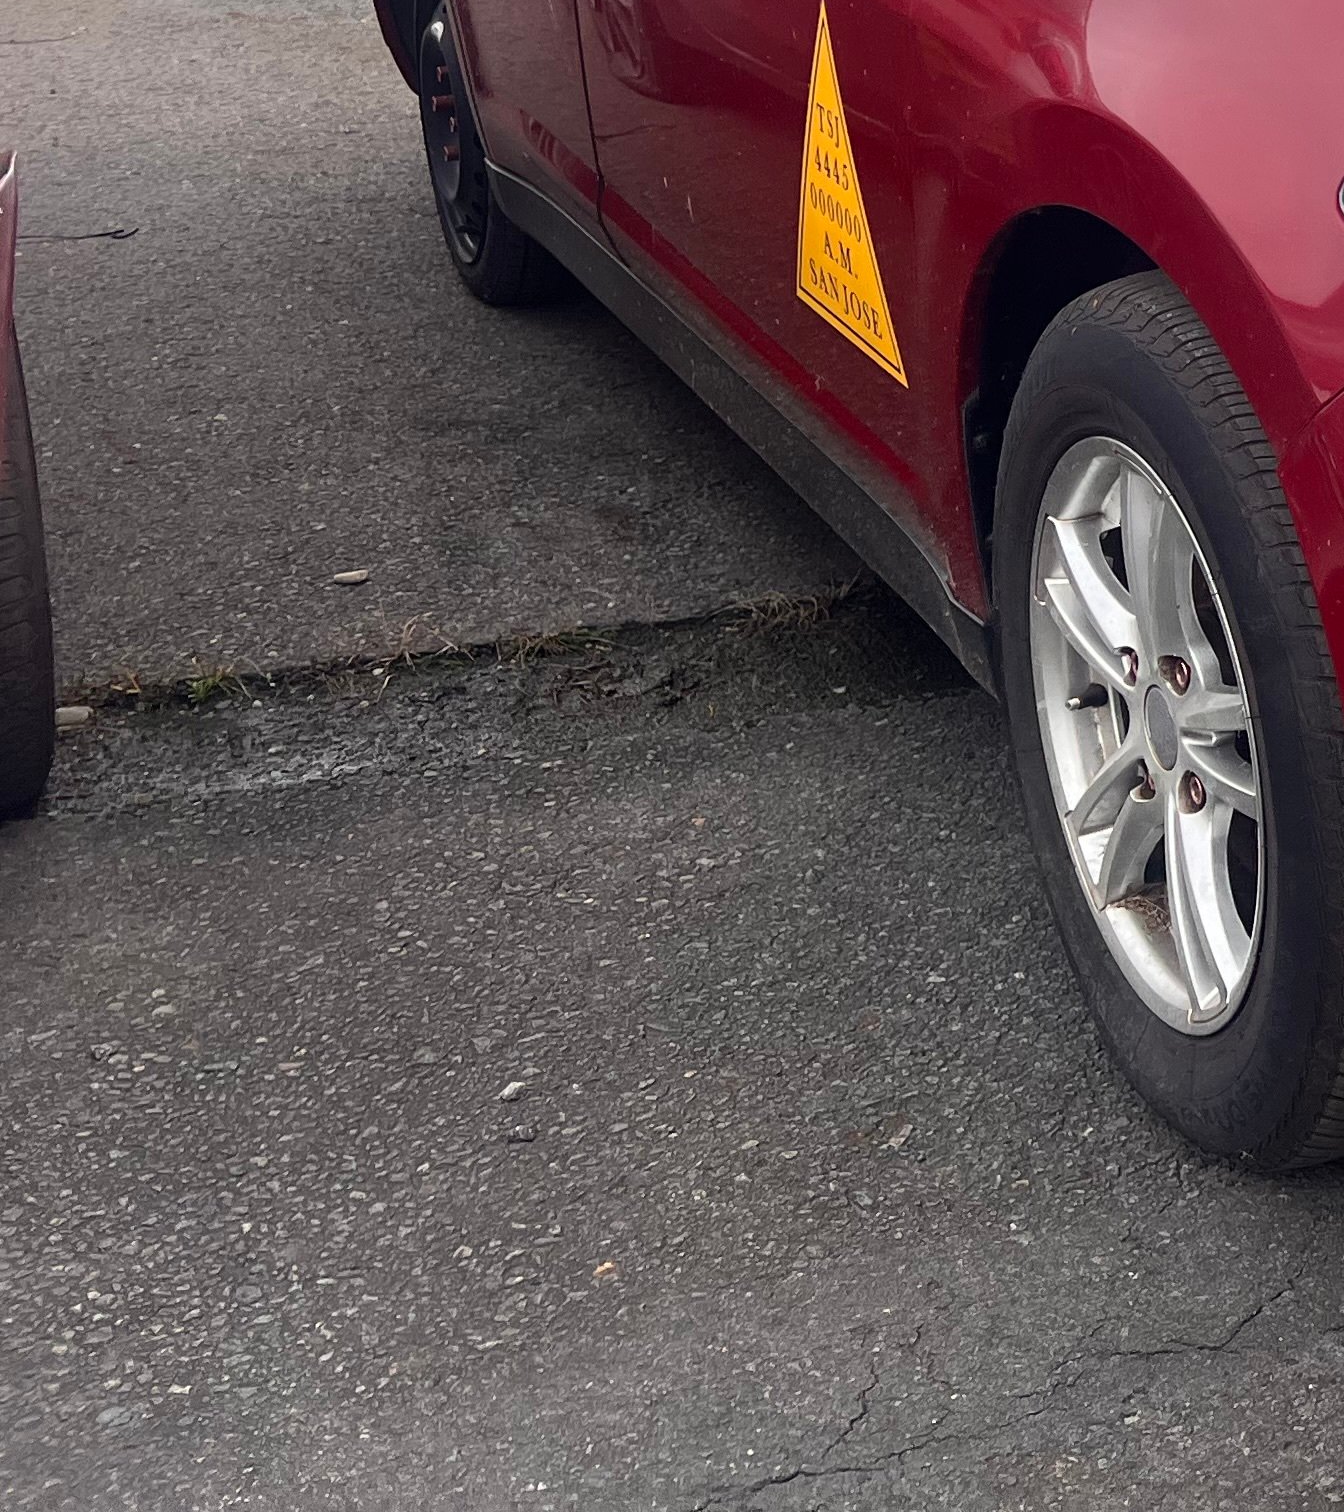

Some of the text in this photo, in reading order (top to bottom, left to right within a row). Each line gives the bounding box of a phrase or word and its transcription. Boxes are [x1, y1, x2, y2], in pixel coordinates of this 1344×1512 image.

[815, 102, 842, 149] TSJ
[813, 144, 850, 191] 4445
[823, 231, 859, 280] A.M.
[808, 258, 883, 340] SAN JOSE
